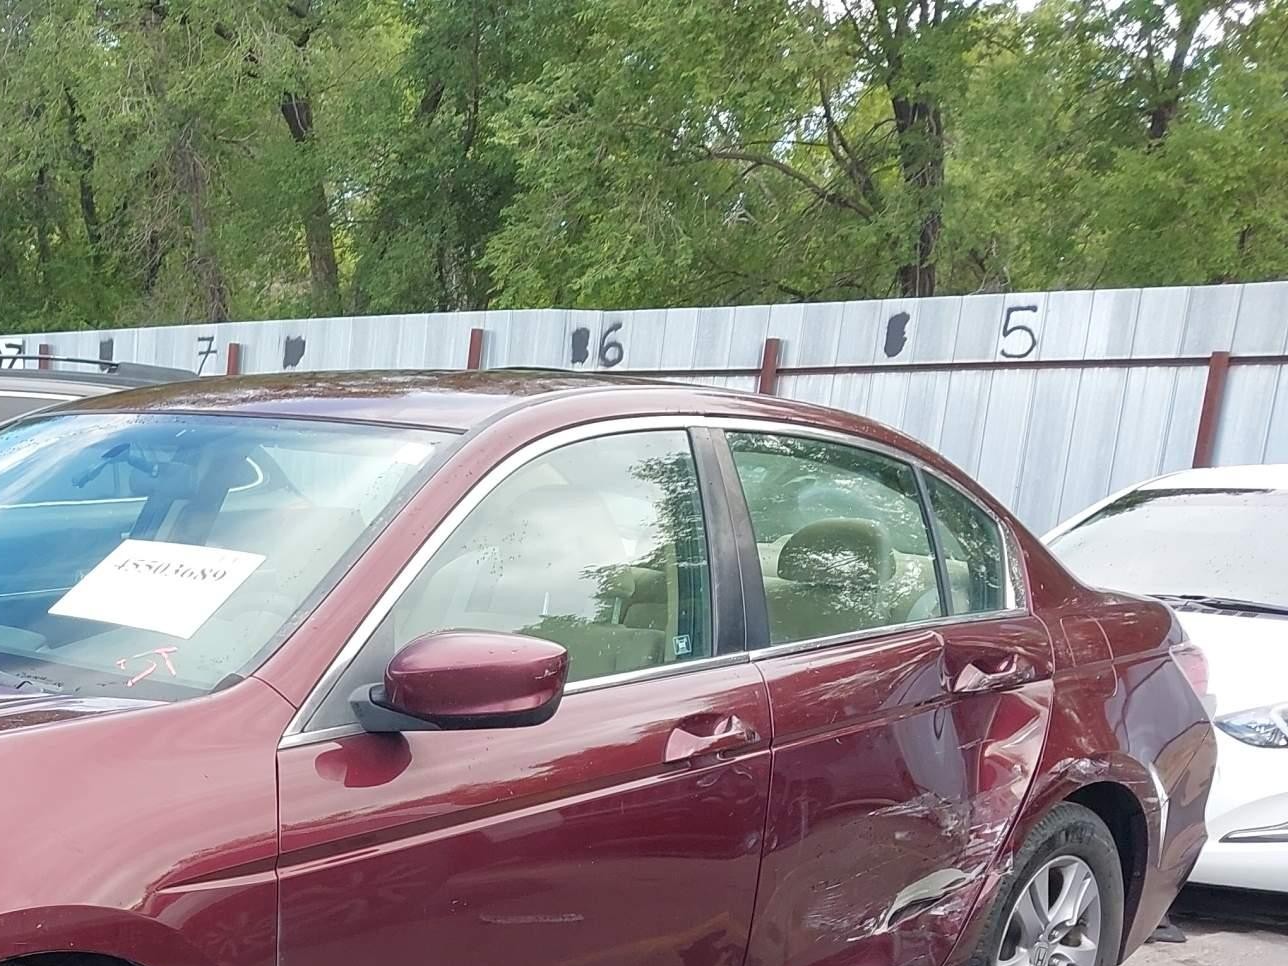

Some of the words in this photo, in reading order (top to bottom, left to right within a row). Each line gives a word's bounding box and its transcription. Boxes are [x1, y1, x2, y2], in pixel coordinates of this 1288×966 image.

[601, 320, 624, 368] 6
[1000, 305, 1038, 358] 5
[197, 336, 217, 376] 7
